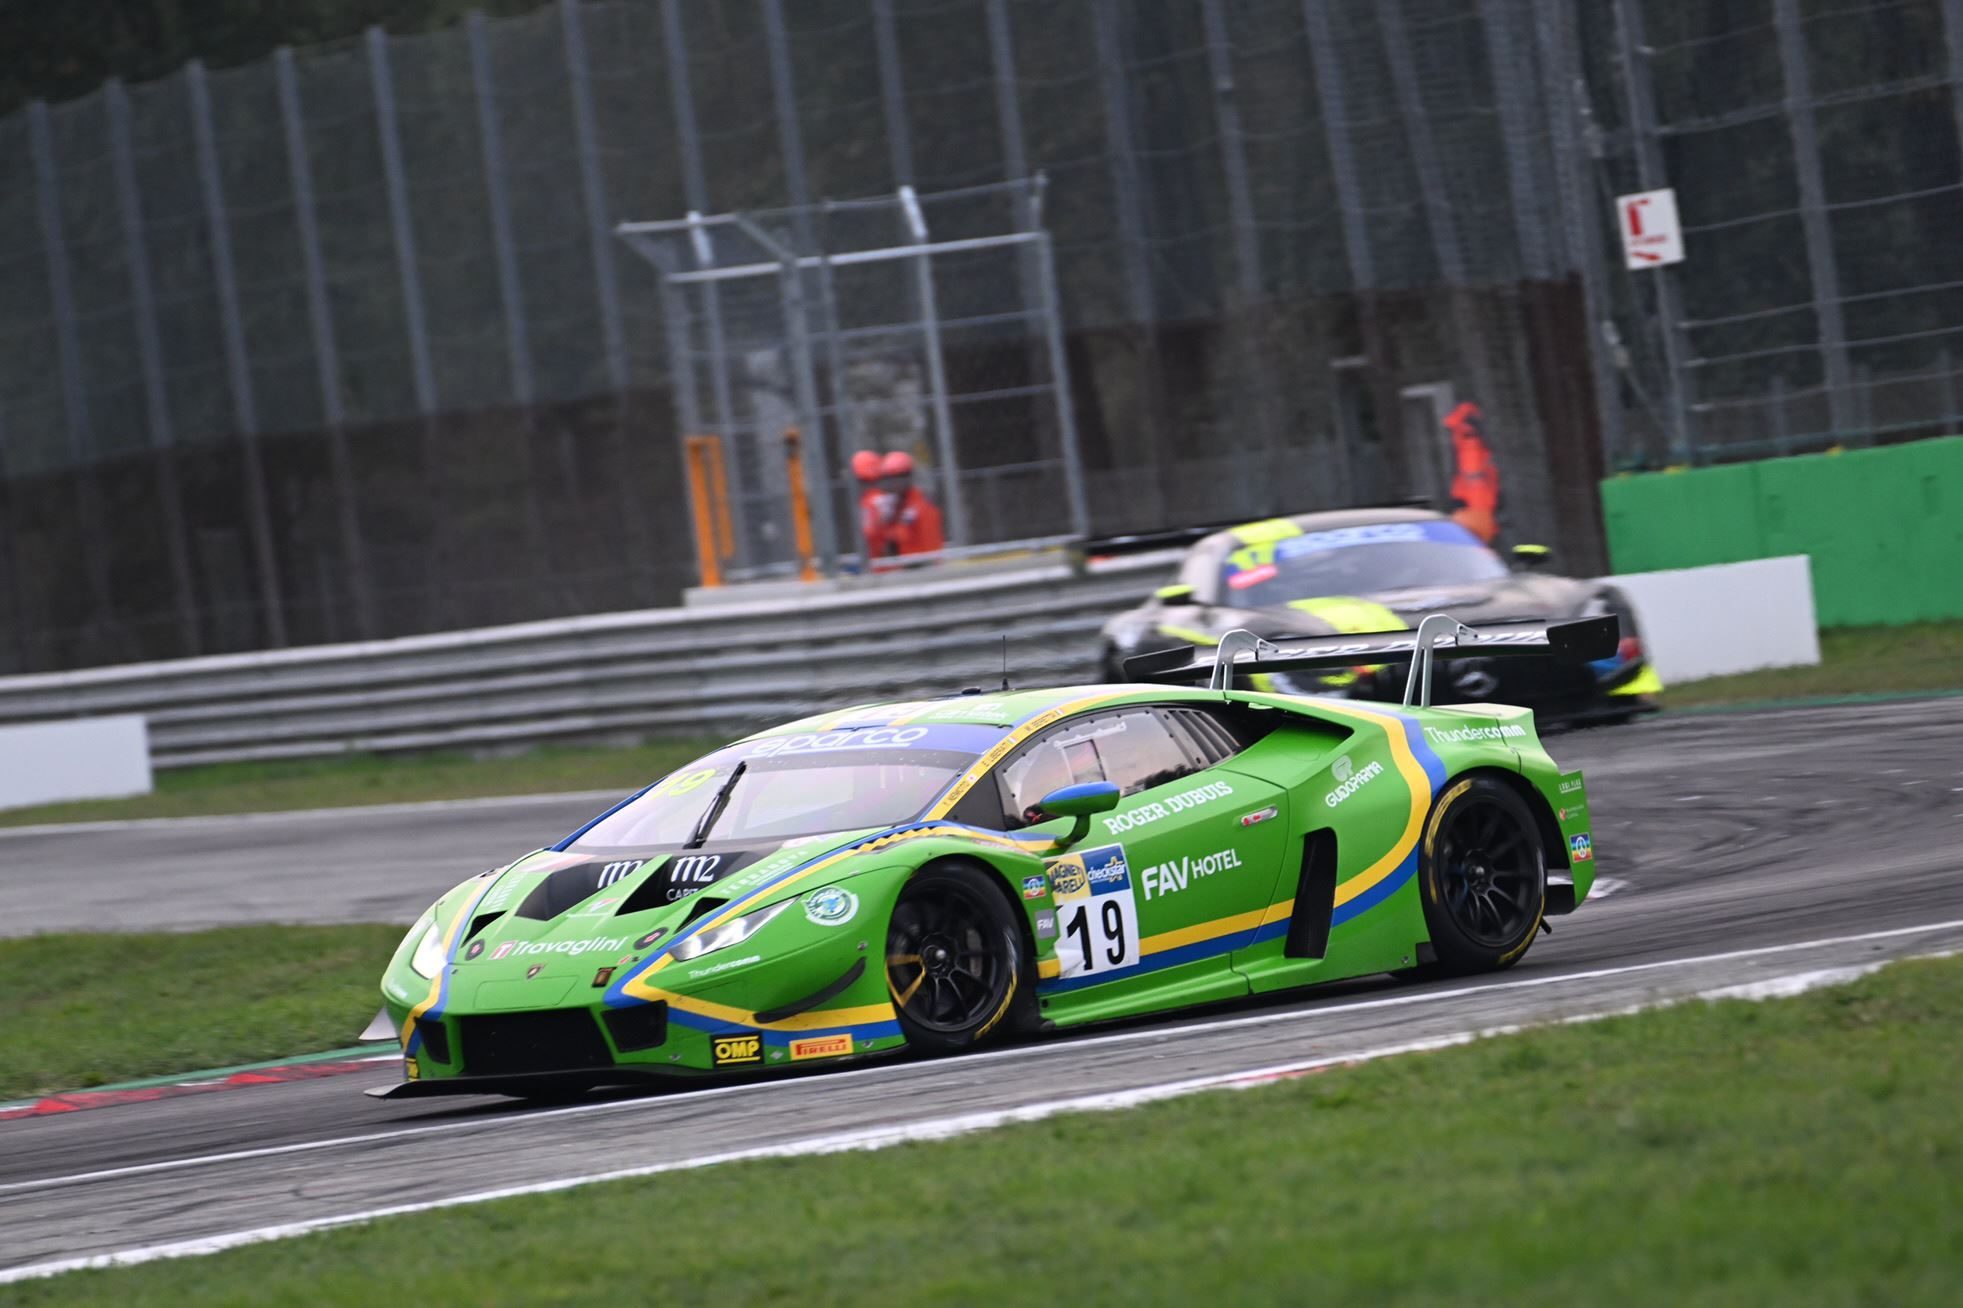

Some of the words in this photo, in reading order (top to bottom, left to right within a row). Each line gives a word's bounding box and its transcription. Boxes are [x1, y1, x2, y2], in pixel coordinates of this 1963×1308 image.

[1424, 724, 1527, 744] Thundercomm
[1325, 761, 1383, 808] GUIDOPARMA
[1102, 803, 1171, 835] ROGER
[1164, 780, 1233, 813] DUBUIS
[1141, 856, 1189, 901] FAV
[1191, 848, 1242, 879] HOTEL
[1037, 917, 1054, 929] FAV
[1066, 899, 1126, 971] 19
[513, 936, 630, 957] Travaglini
[715, 1040, 760, 1059] OMP
[796, 1038, 847, 1056] PIRELLI
